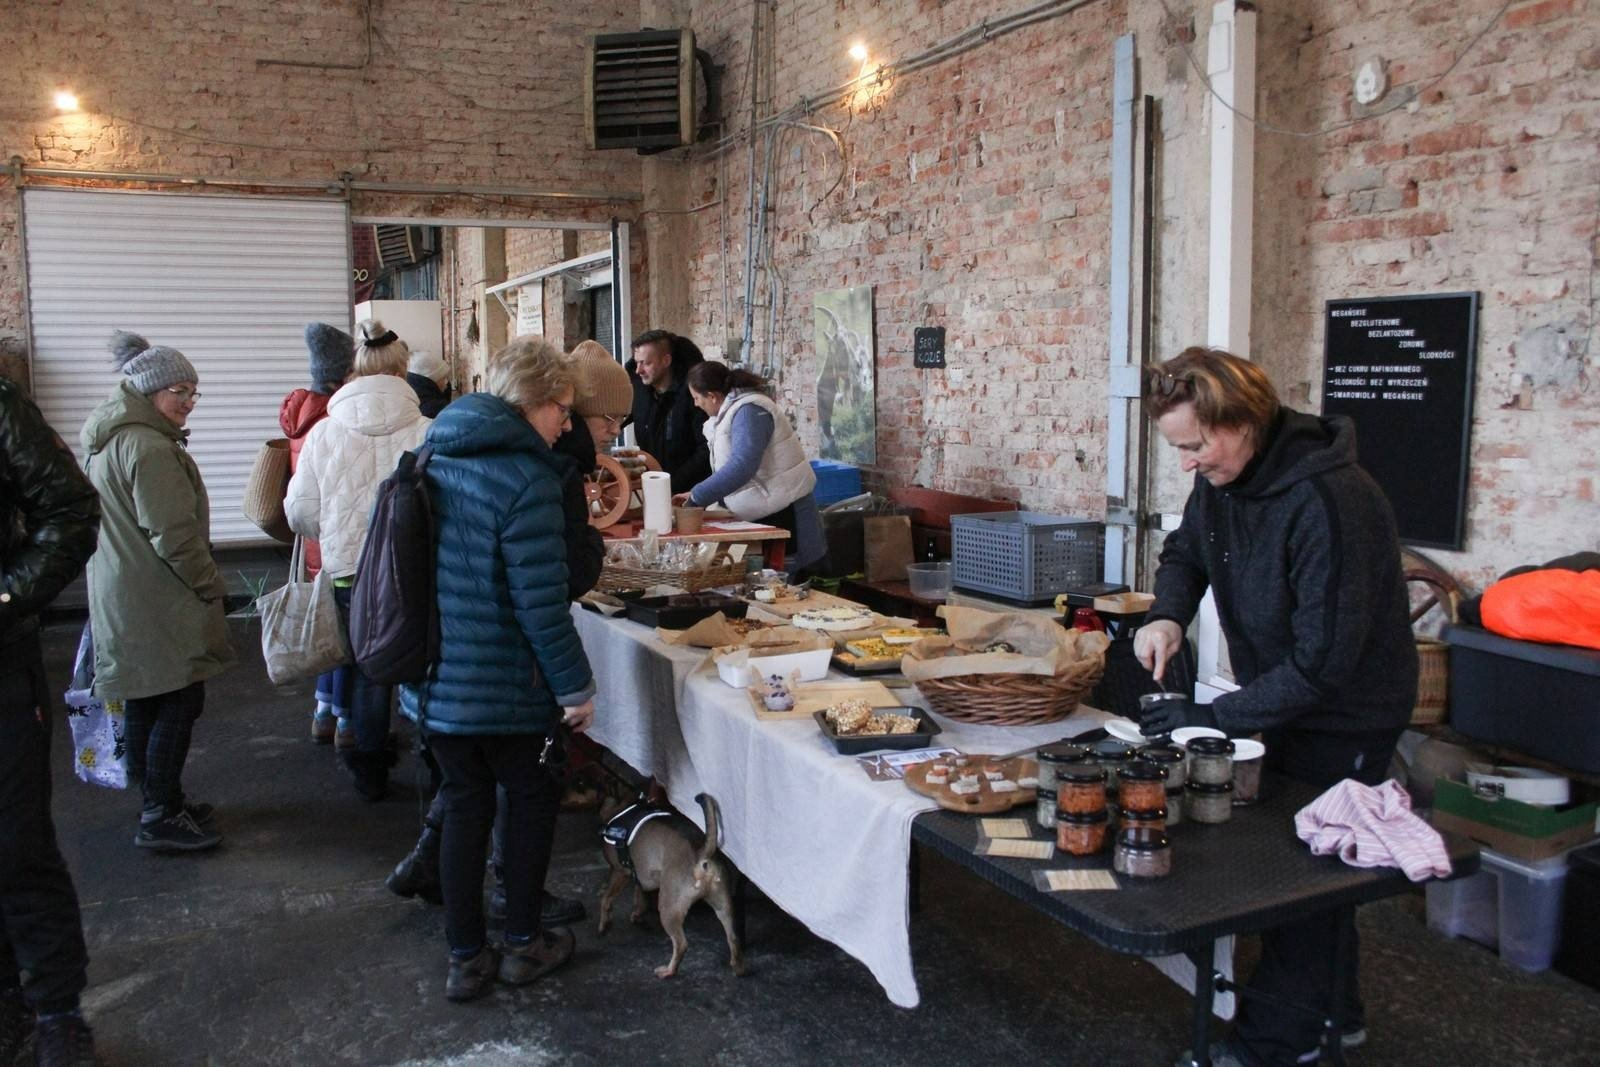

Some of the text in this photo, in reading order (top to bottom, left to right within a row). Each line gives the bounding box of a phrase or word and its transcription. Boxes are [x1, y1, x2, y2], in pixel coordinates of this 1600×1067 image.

[1350, 318, 1400, 327] BEZGLUTENOWE
[1368, 329, 1415, 338] BEZLAKTOZOWE
[1398, 340, 1426, 348] ZDROWE
